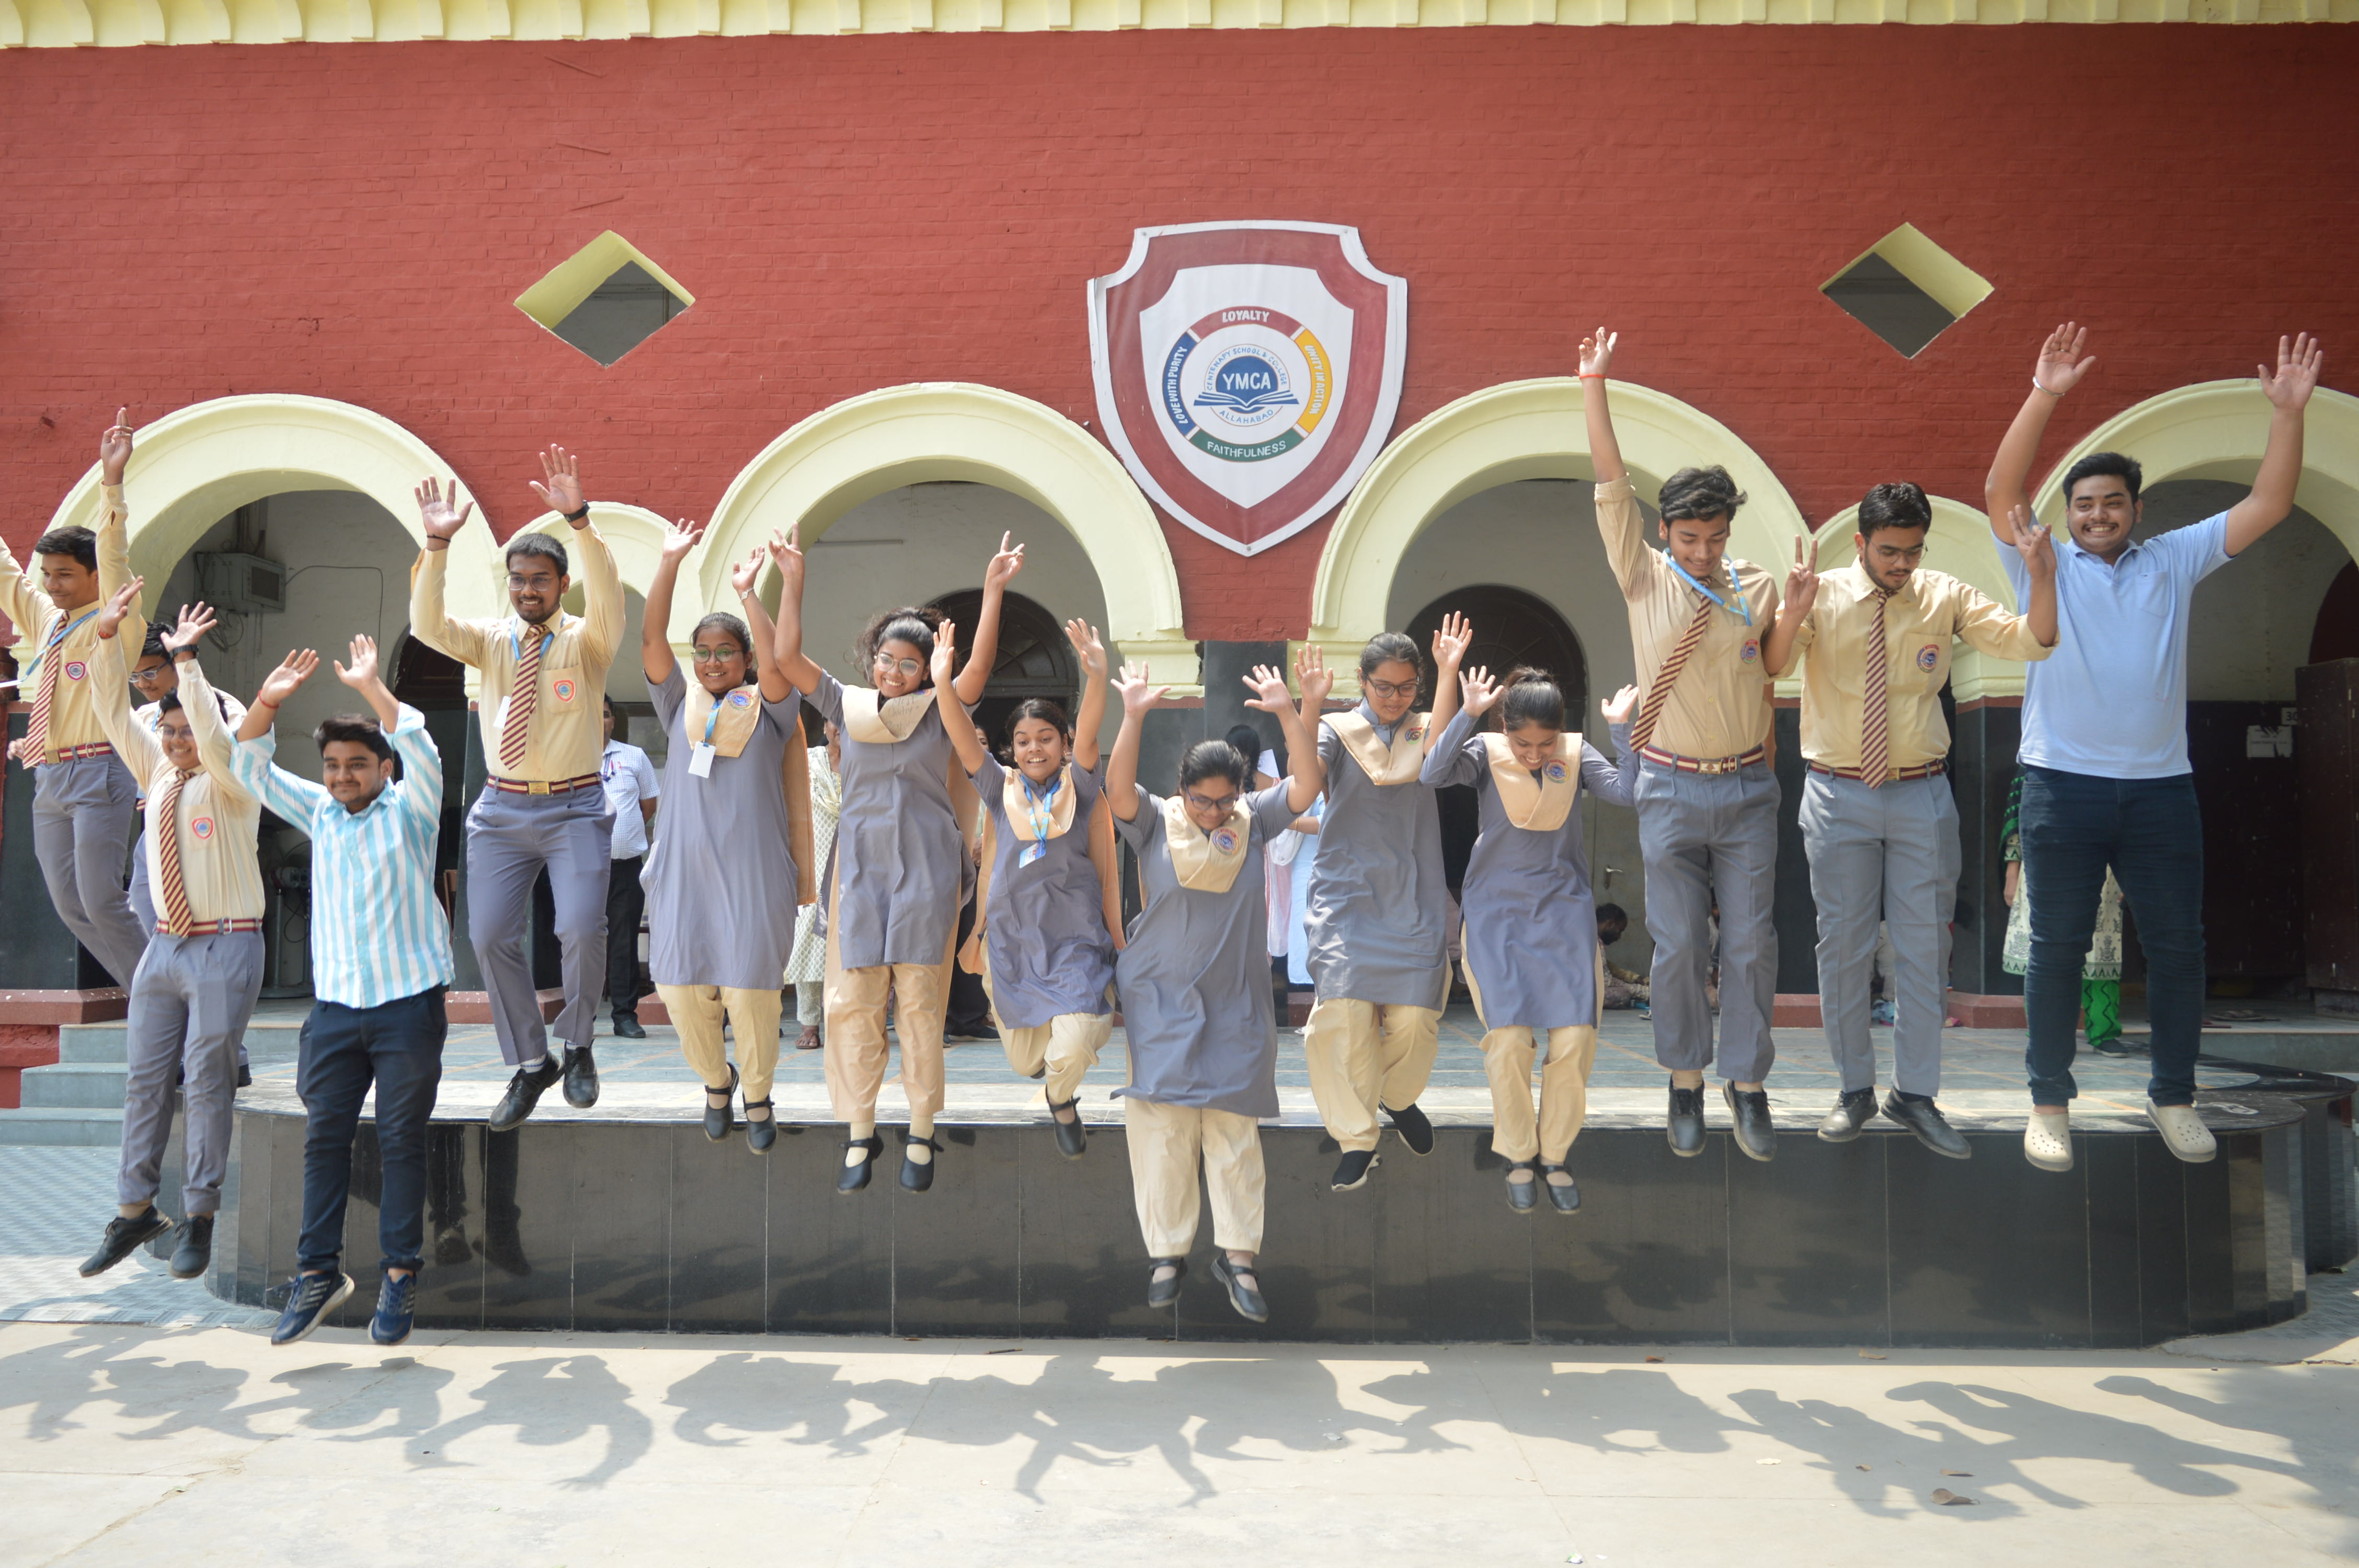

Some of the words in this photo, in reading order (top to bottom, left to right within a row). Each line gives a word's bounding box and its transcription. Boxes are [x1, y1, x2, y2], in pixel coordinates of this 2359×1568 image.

[1222, 310, 1269, 322] LOYALTY
[1233, 347, 1261, 356] SCHOOL
[1304, 345, 1324, 371] UNITY
[1168, 347, 1187, 378] PURITY
[1222, 372, 1271, 390] YMCA
[1315, 372, 1325, 382] IN
[1309, 383, 1326, 414] ACTION
[1219, 409, 1274, 424] ALLAHABAD
[1207, 441, 1286, 458] FAITHFULNESS
